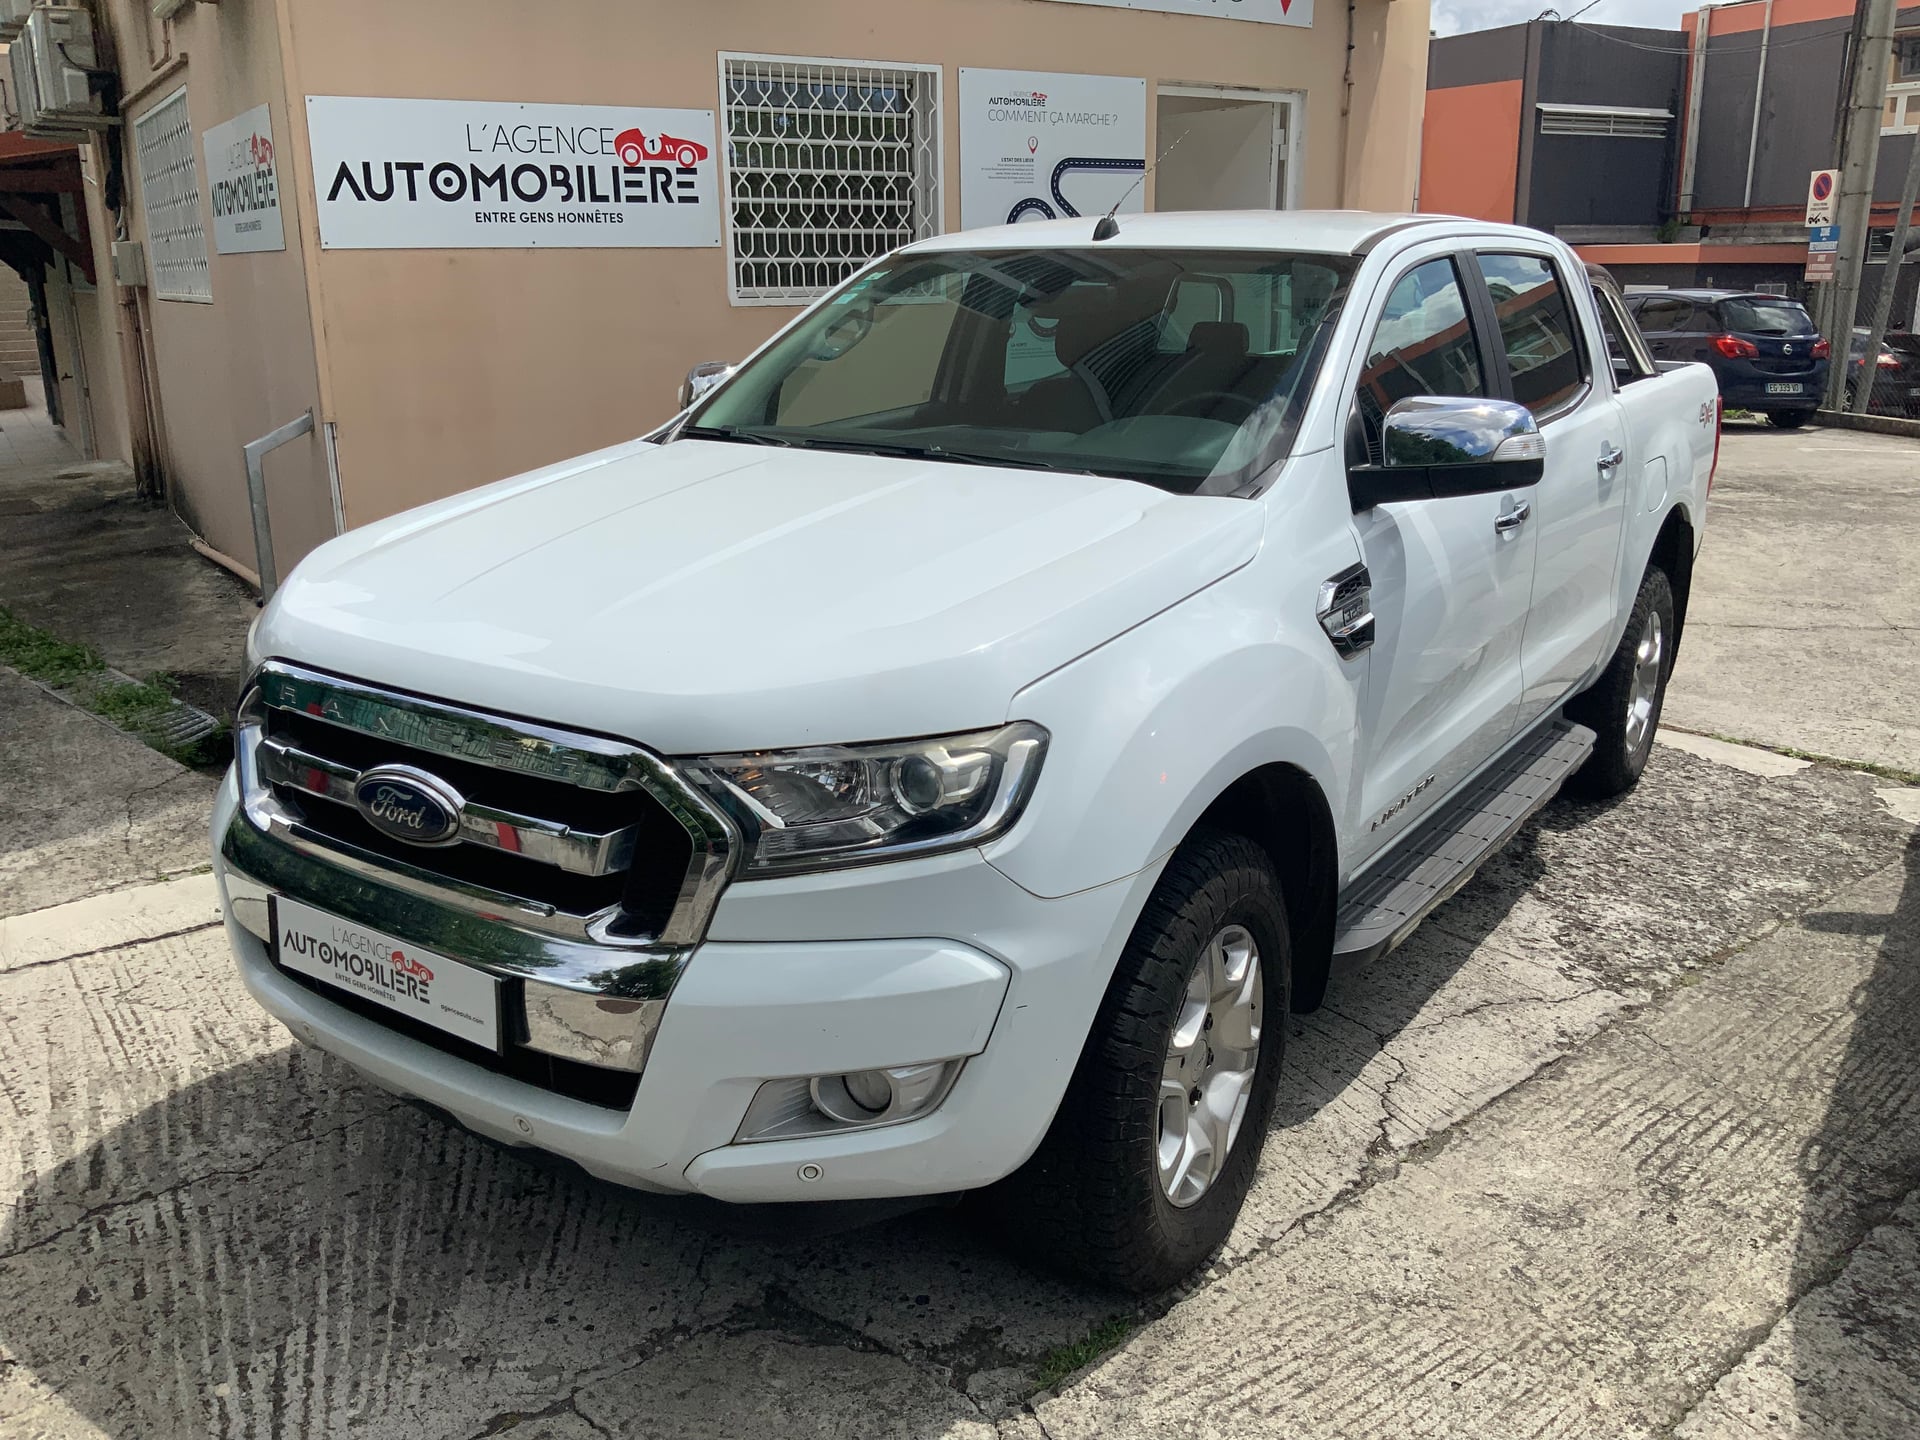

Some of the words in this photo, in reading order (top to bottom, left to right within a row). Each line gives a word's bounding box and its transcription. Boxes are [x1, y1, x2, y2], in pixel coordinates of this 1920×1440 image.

[988, 109, 1048, 123] COMMENT
[1050, 111, 1064, 126] ÇA
[1066, 112, 1110, 126] MARCHE
[1113, 113, 1118, 126] ?
[466, 123, 616, 155] L'AGENCE
[649, 138, 655, 151] 1
[475, 211, 516, 223] ENTRE
[519, 212, 554, 223] GENS
[558, 209, 624, 224] HONNÊTES
[371, 786, 425, 829] Ford
[332, 925, 393, 963] L'AGENCE
[335, 972, 352, 985] ENTRE
[352, 979, 367, 991] GENS
